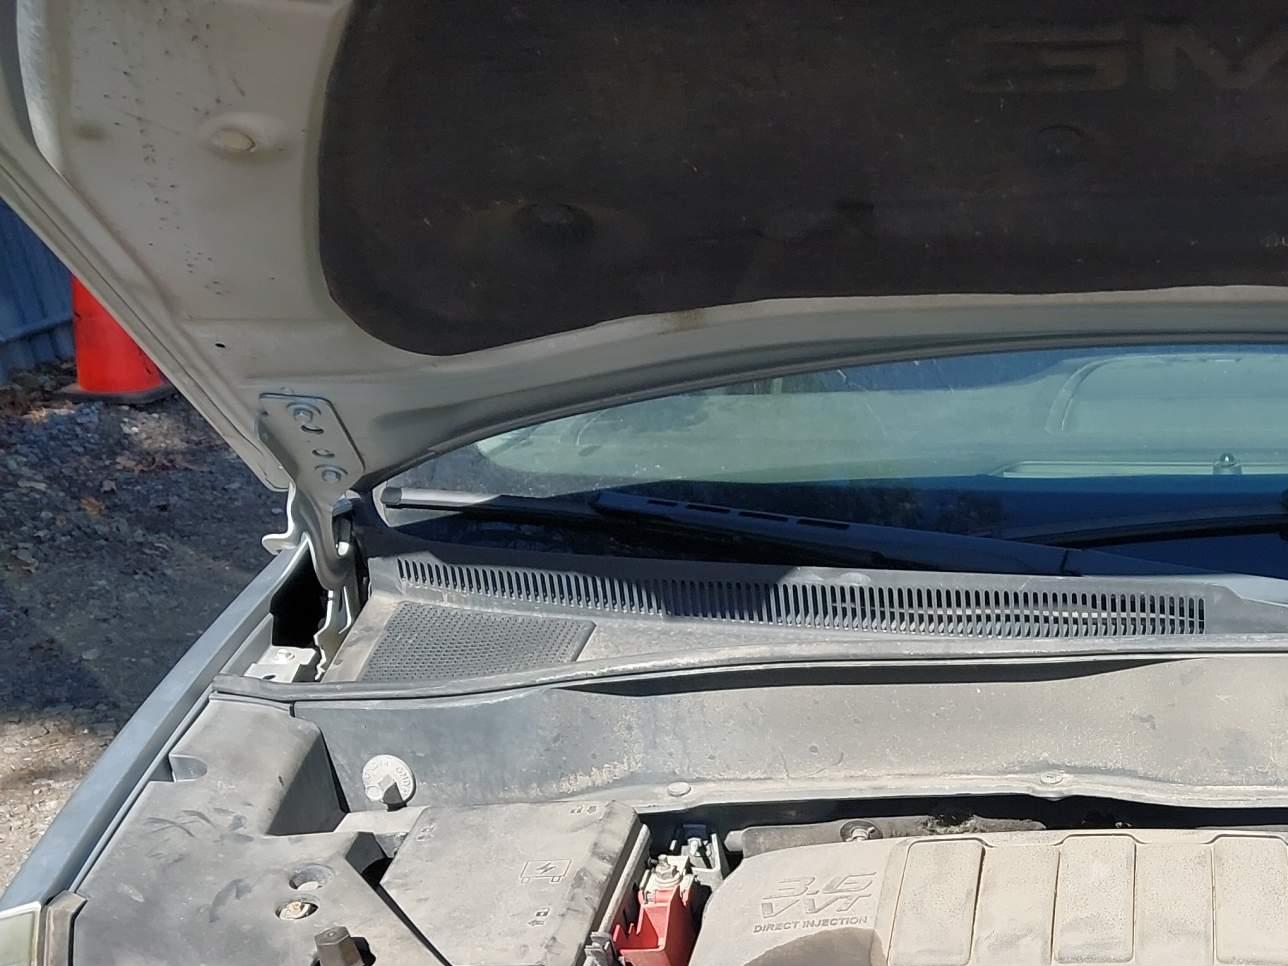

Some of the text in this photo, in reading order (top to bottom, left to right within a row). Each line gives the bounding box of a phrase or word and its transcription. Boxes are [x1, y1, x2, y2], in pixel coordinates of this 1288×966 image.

[761, 893, 872, 919] VVT
[753, 915, 868, 934] DIRECT INJECTION
